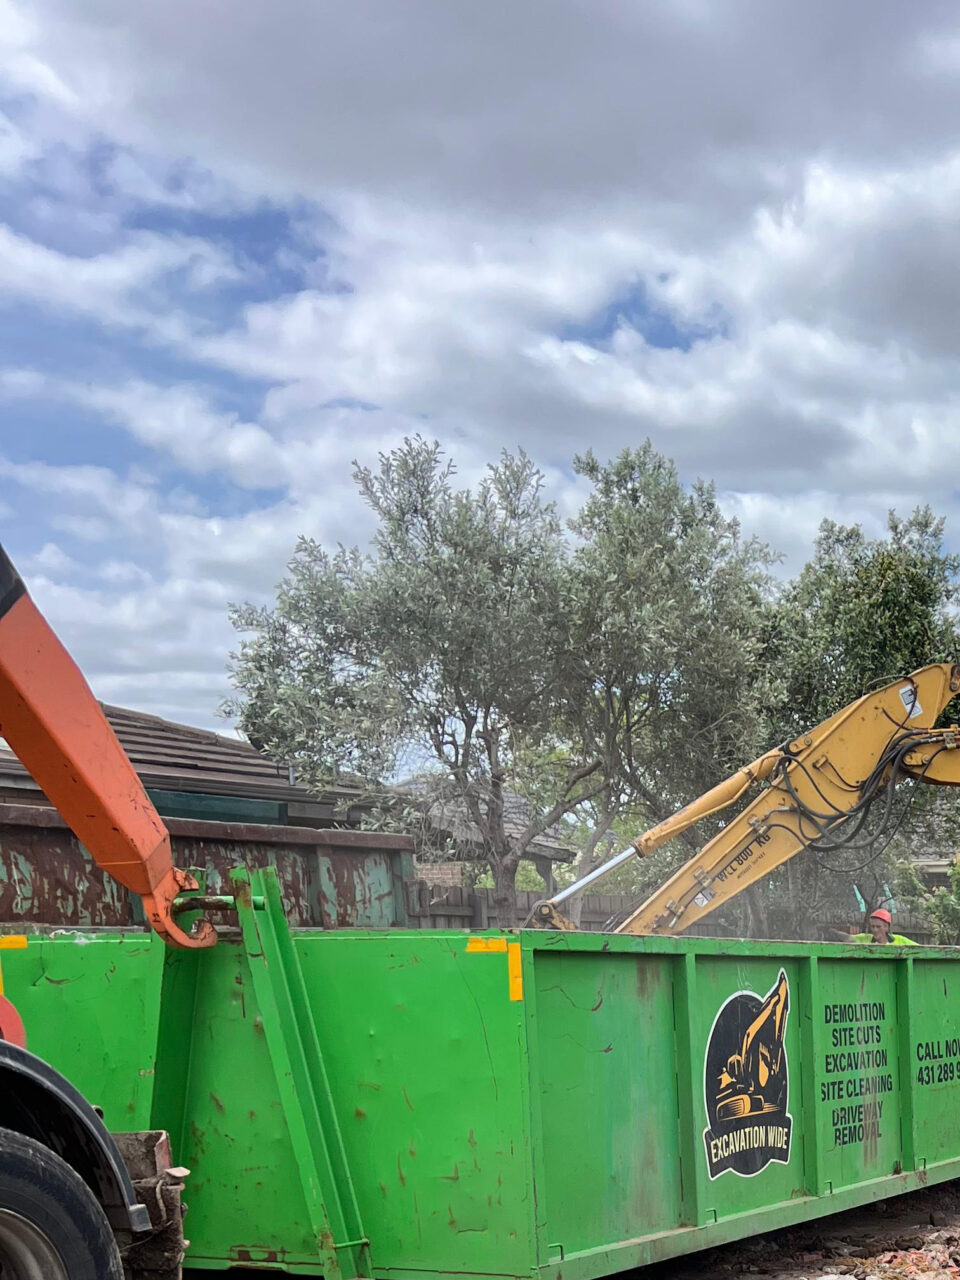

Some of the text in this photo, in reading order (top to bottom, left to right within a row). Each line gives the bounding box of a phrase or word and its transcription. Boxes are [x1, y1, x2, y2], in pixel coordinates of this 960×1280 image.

[735, 846, 753, 866] 800
[824, 1002, 885, 1024] DEMOLITION
[832, 1025, 881, 1046] SITE CUTS
[825, 1050, 887, 1073] EXCAVATION
[916, 1041, 943, 1062] CALL
[917, 1065, 936, 1086] 431
[938, 1062, 955, 1081] 289
[821, 1074, 893, 1101] SITE CLEANING
[832, 1101, 883, 1126] DRIVEWAY
[711, 1126, 788, 1163] EXCAVATION WIDE
[834, 1124, 882, 1146] REMOVAL
